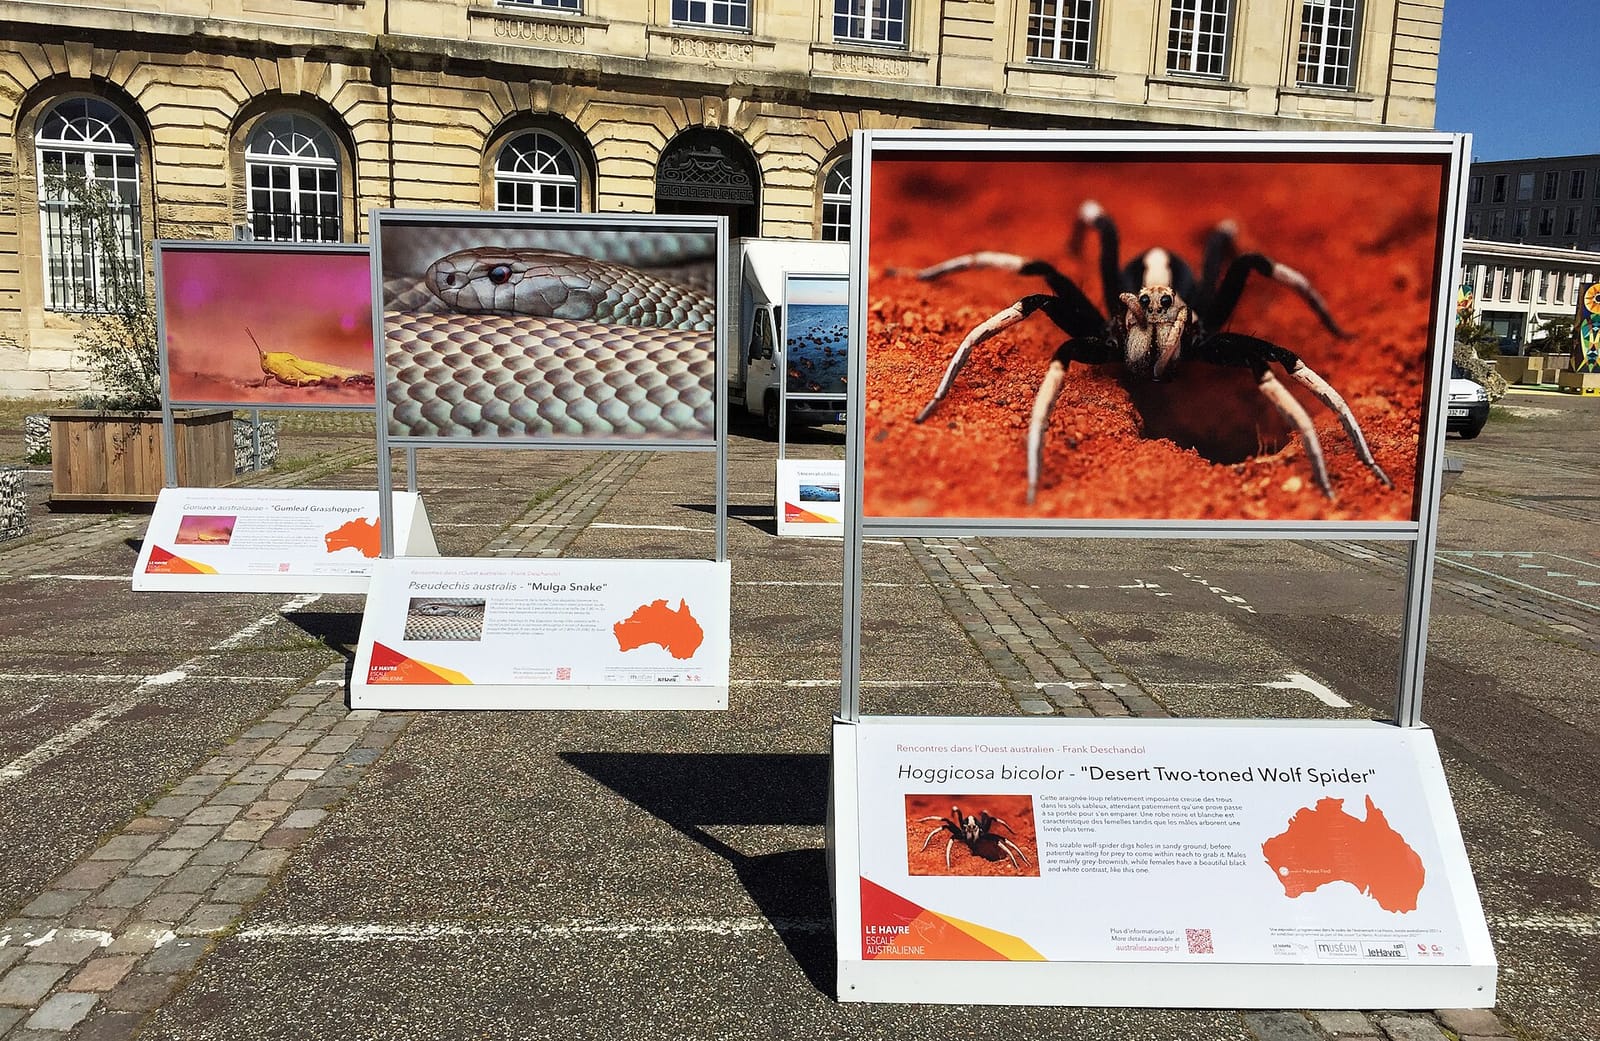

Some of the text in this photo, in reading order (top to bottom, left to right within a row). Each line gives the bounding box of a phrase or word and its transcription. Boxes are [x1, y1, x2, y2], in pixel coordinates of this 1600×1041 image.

[309, 505, 365, 513] Grasshopper"
[408, 581, 470, 591] Pseudechis
[472, 582, 517, 591] australis
[528, 582, 567, 593] "Mulga
[569, 583, 608, 592] Snake"
[897, 744, 948, 753] Rencontres
[950, 745, 973, 753] dans
[975, 745, 1007, 753] l'Ouest
[1010, 745, 1054, 753] australien
[1062, 746, 1087, 754] Frank
[1090, 746, 1146, 754] Deschandol
[898, 764, 995, 783] Hoggicosa
[1001, 765, 1064, 780] bicolor
[1081, 766, 1150, 781] "Desert
[1153, 766, 1253, 782] Two-toned
[1257, 767, 1302, 783] Wolf
[1307, 768, 1376, 787] Spider"
[866, 926, 910, 934] LE HAVRE
[866, 936, 895, 945] ESCALE
[867, 946, 925, 954] AUSTRALIENNE
